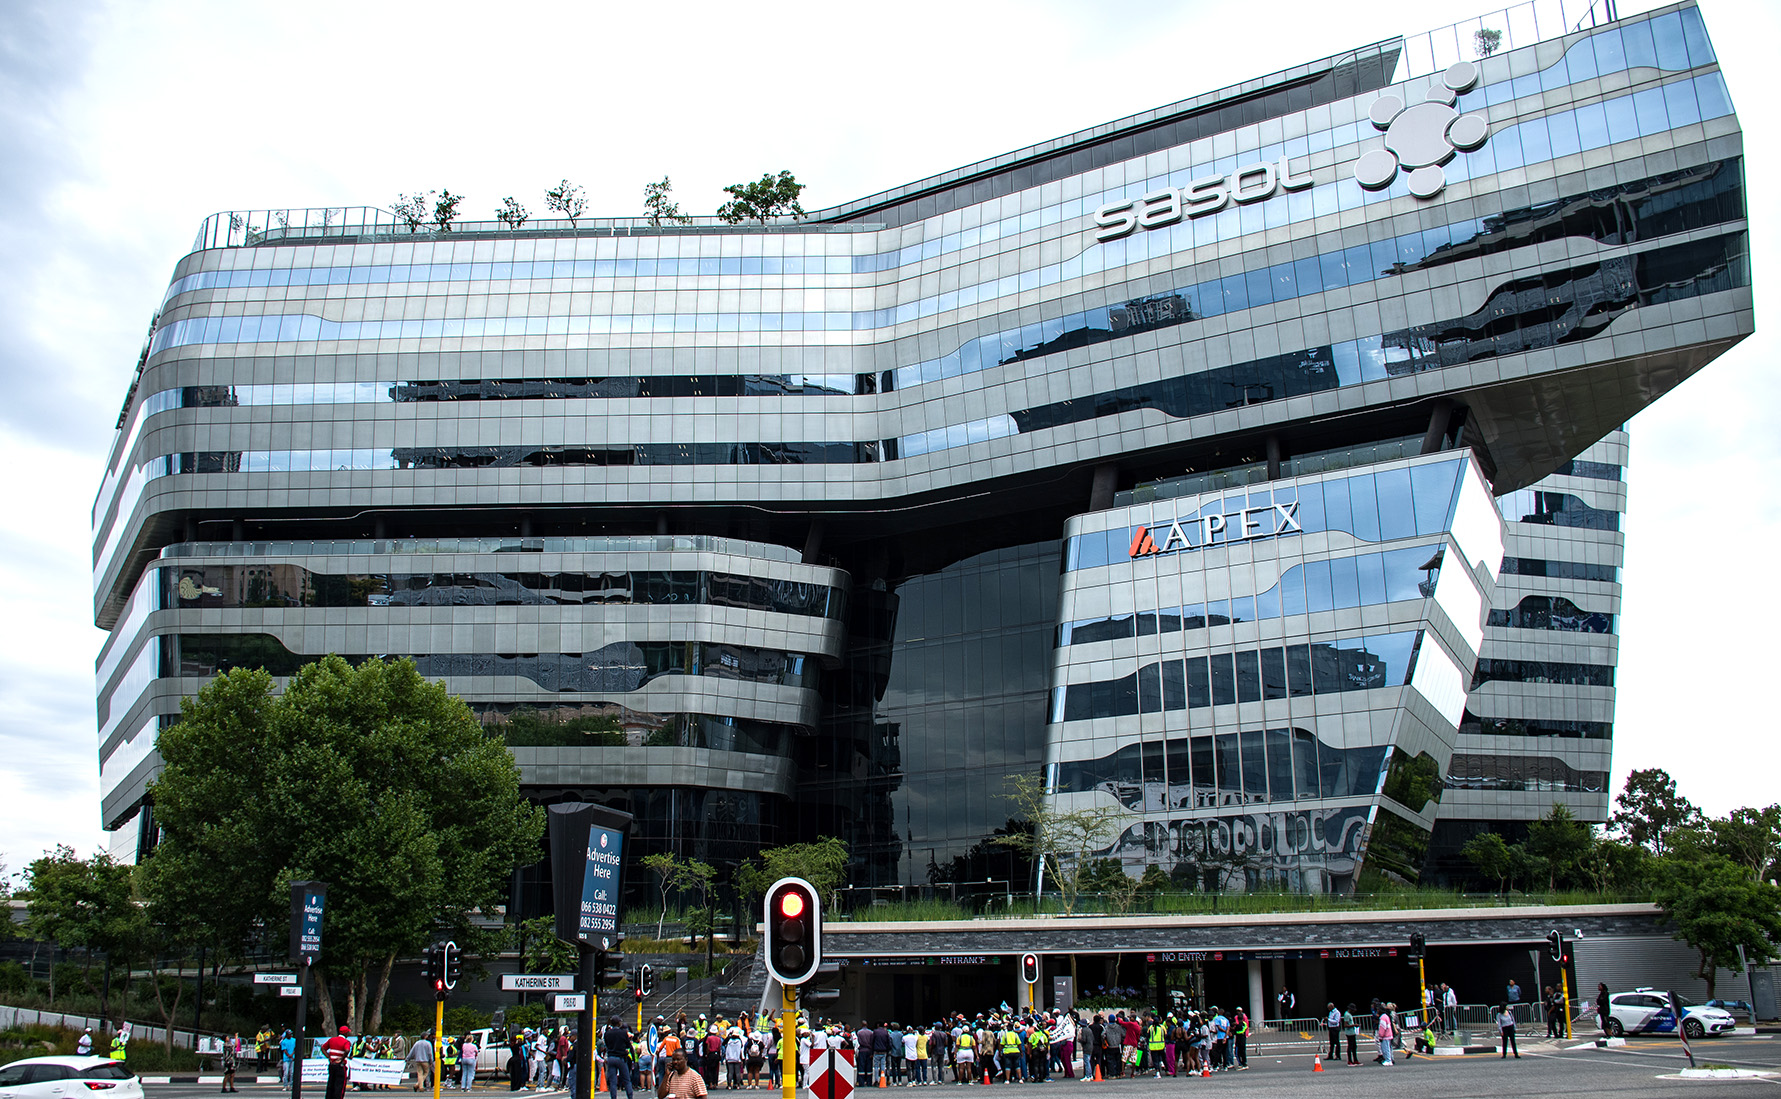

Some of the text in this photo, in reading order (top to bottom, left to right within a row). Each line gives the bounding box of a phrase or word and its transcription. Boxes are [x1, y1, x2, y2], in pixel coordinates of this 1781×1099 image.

[1162, 500, 1302, 551] APEX
[586, 847, 620, 866] Advertise
[594, 864, 611, 879] Here
[594, 889, 607, 901] Call:
[304, 905, 323, 914] Advertise
[581, 901, 616, 916] 066 538 0422
[308, 914, 318, 922] Here
[580, 917, 615, 931] 082 555 2954
[1162, 952, 1208, 961] NO ENTRY
[1334, 949, 1381, 958] NO ENTRY
[940, 957, 986, 965] ENTRANCE
[515, 978, 560, 987] KATHERINE STR
